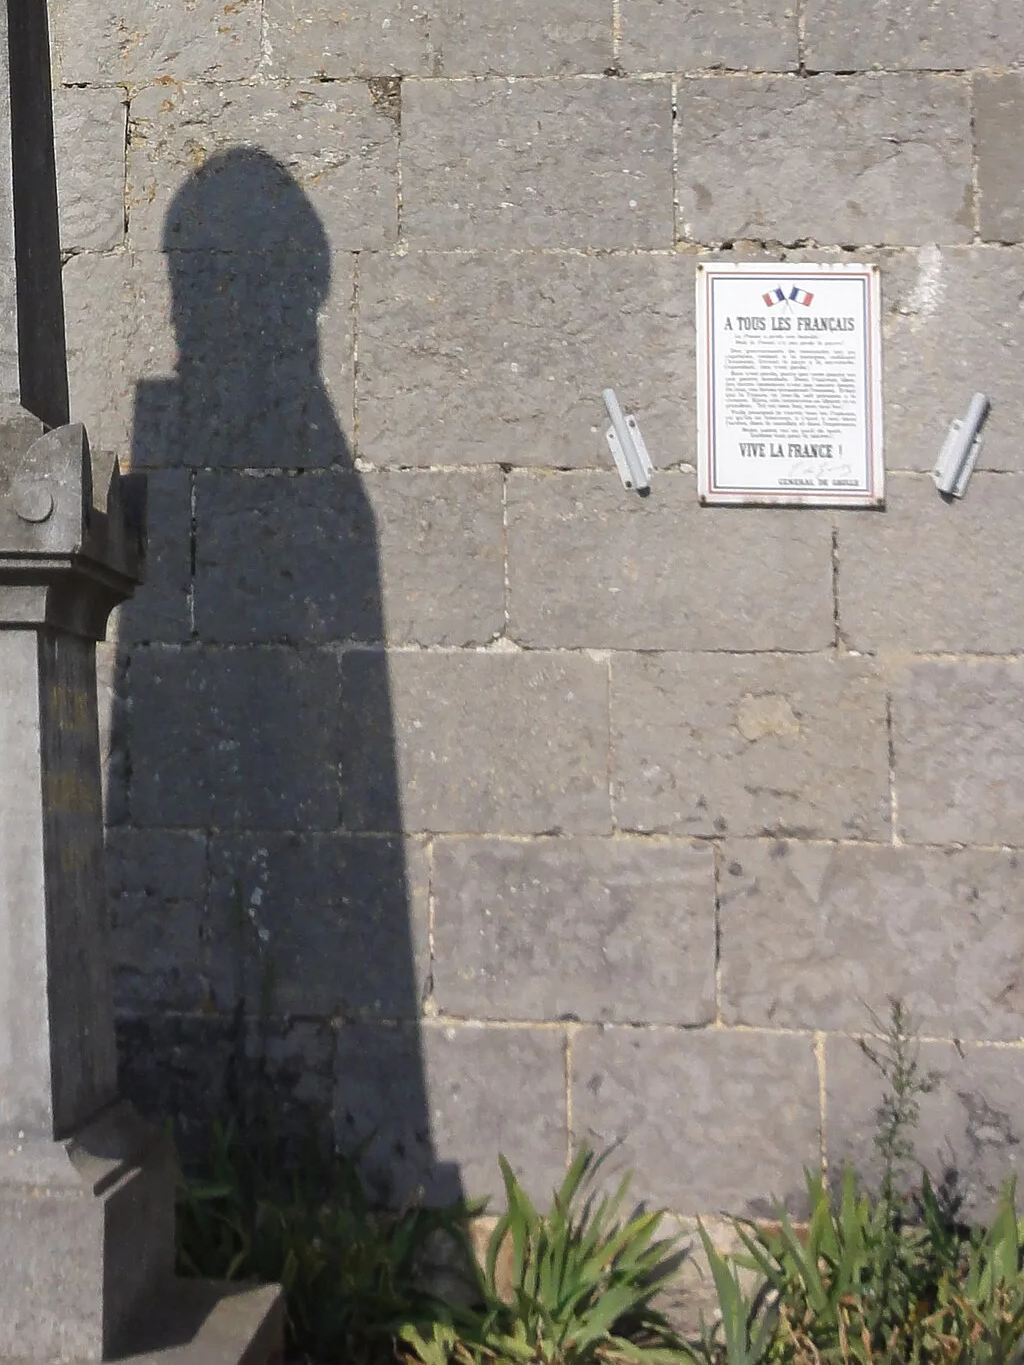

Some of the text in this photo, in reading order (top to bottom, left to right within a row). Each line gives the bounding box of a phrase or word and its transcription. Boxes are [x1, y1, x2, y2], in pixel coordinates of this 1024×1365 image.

[724, 316, 855, 333] A TOUS LES FRANÇAIS
[739, 442, 766, 458] VIVE
[770, 443, 785, 458] LA
[788, 443, 833, 458] FRANCE
